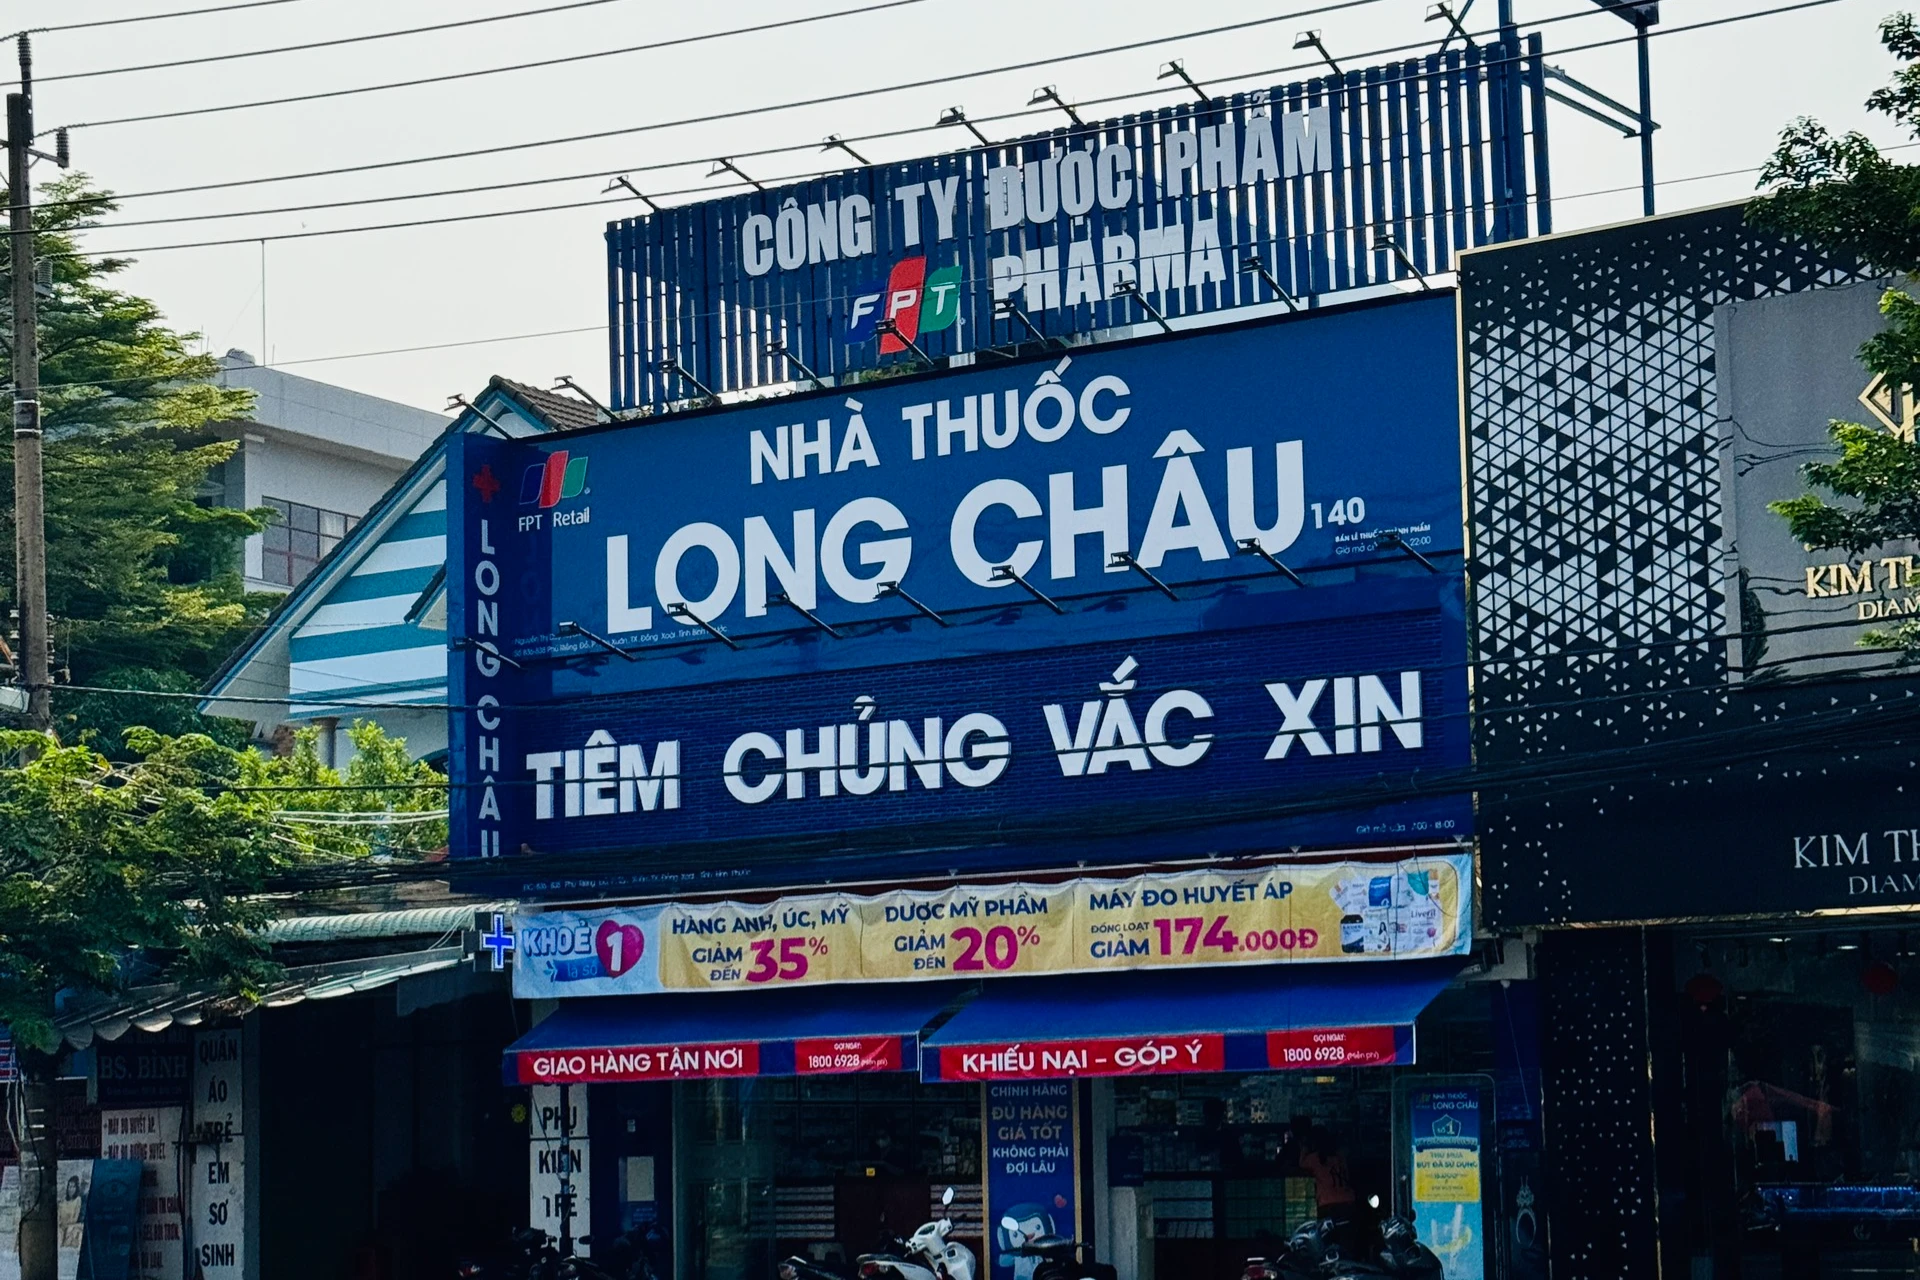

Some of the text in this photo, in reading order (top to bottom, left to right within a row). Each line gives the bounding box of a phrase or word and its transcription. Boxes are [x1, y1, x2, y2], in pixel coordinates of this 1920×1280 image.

[742, 92, 1333, 277] CÔNG TY DƯỢC PHẨM
[991, 219, 1227, 320] PHARMA
[850, 283, 957, 330] FPT
[750, 355, 1132, 485] NHÀ THUỐC
[518, 506, 590, 532] FPT Retail
[1310, 496, 1366, 529] 140
[606, 428, 1306, 635] LONG CHÂU
[1804, 559, 1874, 599] KIM
[474, 518, 502, 858] LONG CHÂU
[525, 655, 1423, 820] TIÊM CHỦNG VẮC XIN
[1793, 832, 1870, 869] KIM
[1089, 877, 1294, 911] MÁY ĐO HUYẾT ÁP
[672, 903, 850, 935] HÀNG ANH, ÚC, MỸ
[885, 901, 946, 926] DƯỢC
[949, 897, 980, 918] MỸ
[1122, 921, 1150, 935] LOẠT
[605, 931, 624, 973] 1
[691, 936, 829, 983] GIẢM 35%
[894, 924, 1041, 972] GIẢM 20%
[1090, 933, 1150, 959] GIẢM
[709, 962, 741, 981] ĐẾN
[913, 952, 946, 970] ĐẾN
[199, 1031, 238, 1066] QUẦN
[1313, 1034, 1327, 1044] GỌI
[533, 1046, 743, 1077] GIAO HÀNG TẬN NƠI
[808, 1055, 832, 1069] 1800
[834, 1054, 860, 1068] 6928
[962, 1043, 1035, 1073] KHIẾU
[1042, 1049, 1088, 1075] NẠI
[1114, 1040, 1178, 1068] GÓP
[1184, 1038, 1203, 1064] Ý
[1283, 1048, 1312, 1063] 1800
[1314, 1046, 1345, 1061] 6928
[207, 1074, 228, 1103] ÁO
[991, 1084, 1029, 1098] CHÍNH
[1019, 1102, 1069, 1120] HÀNG
[1432, 1101, 1456, 1110] LONG
[1455, 1099, 1479, 1110] CHÂU
[997, 1120, 1062, 1141] GIÁ TỐT
[992, 1142, 1070, 1158] KHÔNG PHẢI
[208, 1161, 230, 1185] EM
[1005, 1159, 1056, 1176] ĐỢI LÂU
[208, 1199, 229, 1226] SƠ
[201, 1243, 235, 1267] SINH
